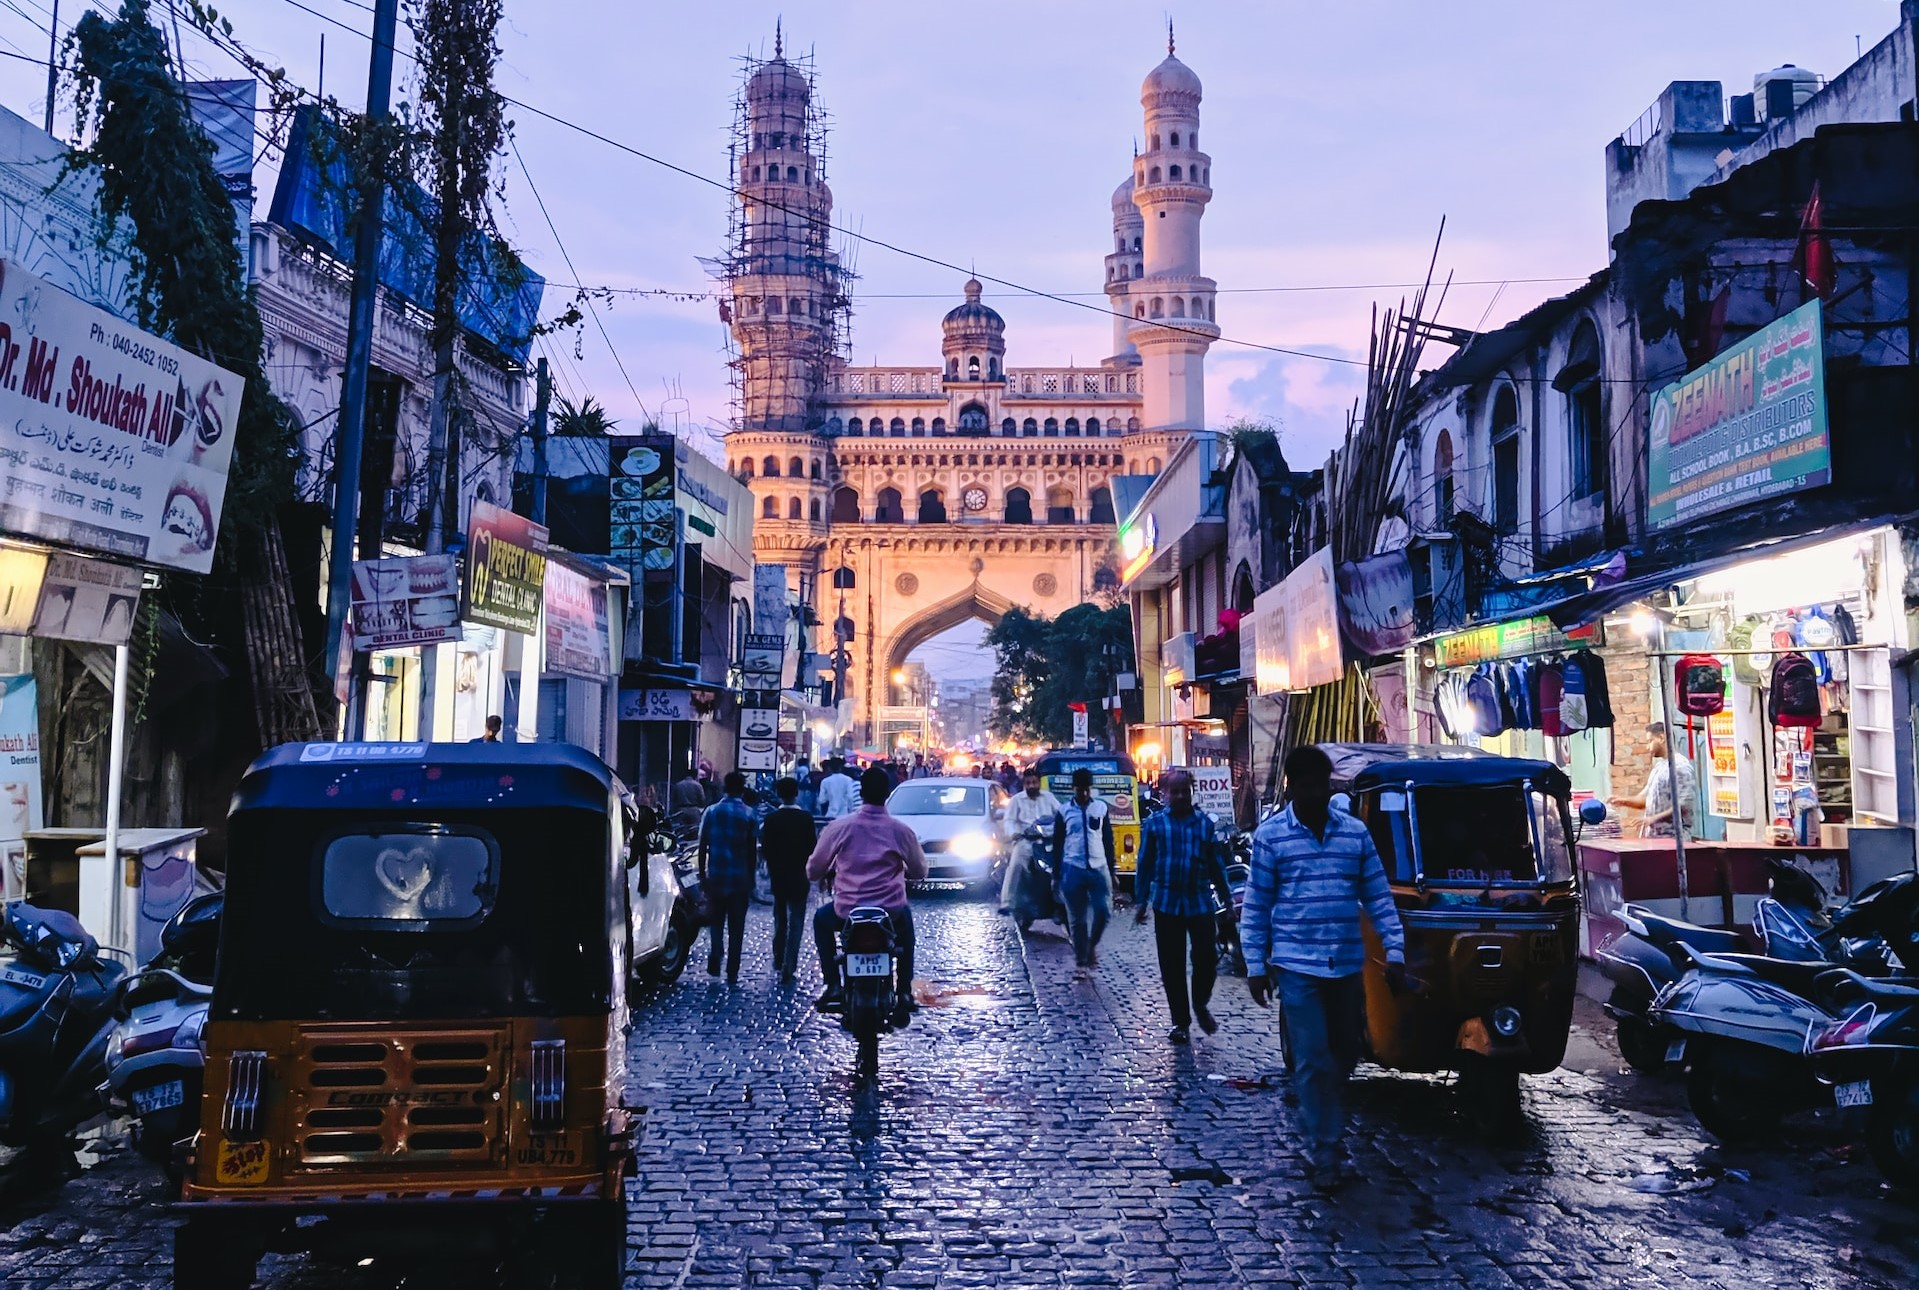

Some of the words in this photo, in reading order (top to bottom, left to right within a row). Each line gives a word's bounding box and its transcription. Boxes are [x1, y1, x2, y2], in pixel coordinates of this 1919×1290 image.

[112, 333, 156, 366] 040-2452
[157, 354, 179, 376] 1052
[67, 355, 147, 437] Shoukath
[1669, 346, 1754, 446] ZEENATH
[1731, 390, 1815, 444] DISTRIBUTORS
[1669, 470, 1682, 485] ALL
[1682, 461, 1707, 479] SCHOOL
[1779, 419, 1812, 443] B.COM
[1675, 482, 1725, 512] WHOLESALE
[1735, 468, 1773, 490] RETAIL
[491, 538, 525, 579] PERFECT
[491, 579, 516, 608] DENTAL
[373, 632, 409, 643] DENTAL
[412, 629, 446, 640] CLINIC
[10, 756, 38, 765] Dentist
